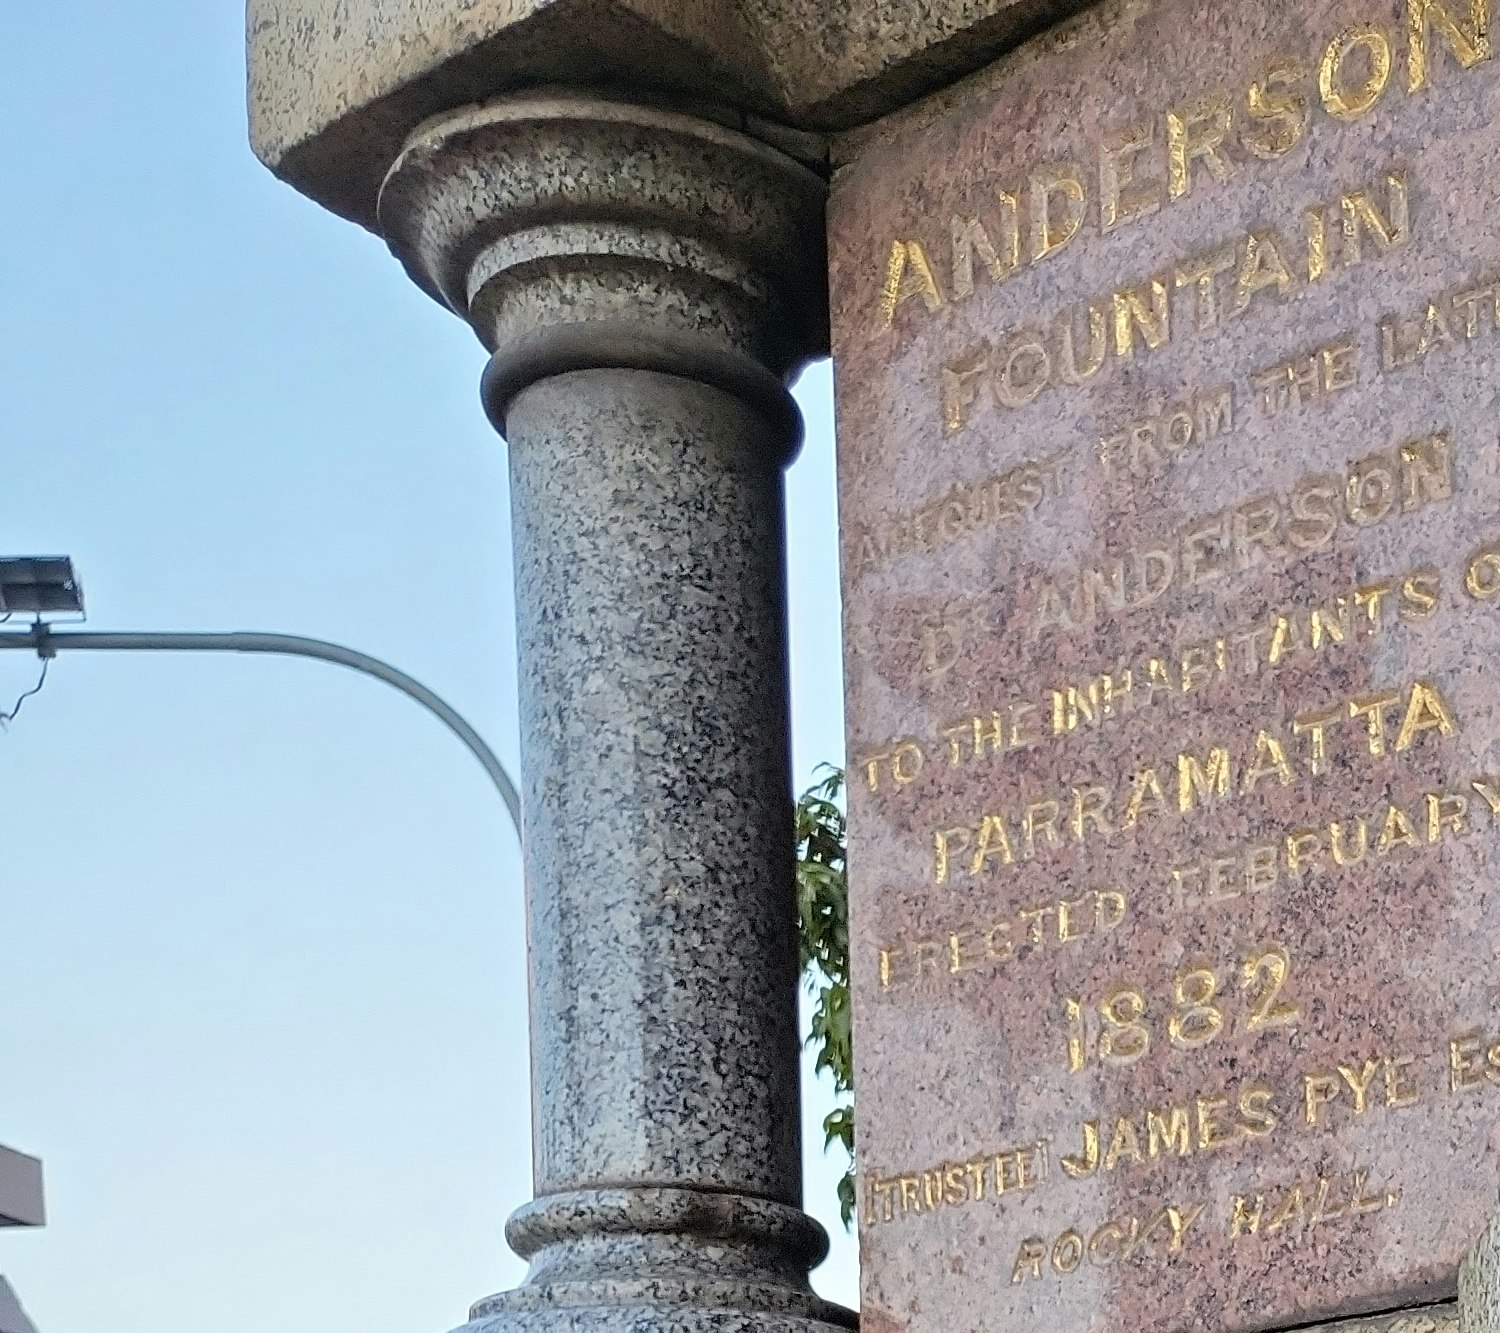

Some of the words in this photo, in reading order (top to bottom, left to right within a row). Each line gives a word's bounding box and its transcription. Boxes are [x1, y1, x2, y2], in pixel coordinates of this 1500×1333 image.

[881, 0, 1492, 330] ANDERSON
[941, 168, 1410, 435] FOUNTAIN
[1099, 382, 1235, 479] FROM
[1251, 340, 1359, 414] THE
[1030, 432, 1453, 640] ANDERSON
[860, 742, 924, 794] TO
[943, 704, 1034, 768] THE
[1053, 572, 1441, 736] INHABITANTS
[935, 682, 1459, 886] PARRAMATTA
[880, 890, 1127, 988] ERECTED
[1064, 945, 1301, 1074] 1882
[1060, 1086, 1278, 1180] JAMES
[1303, 1054, 1420, 1127] PYE
